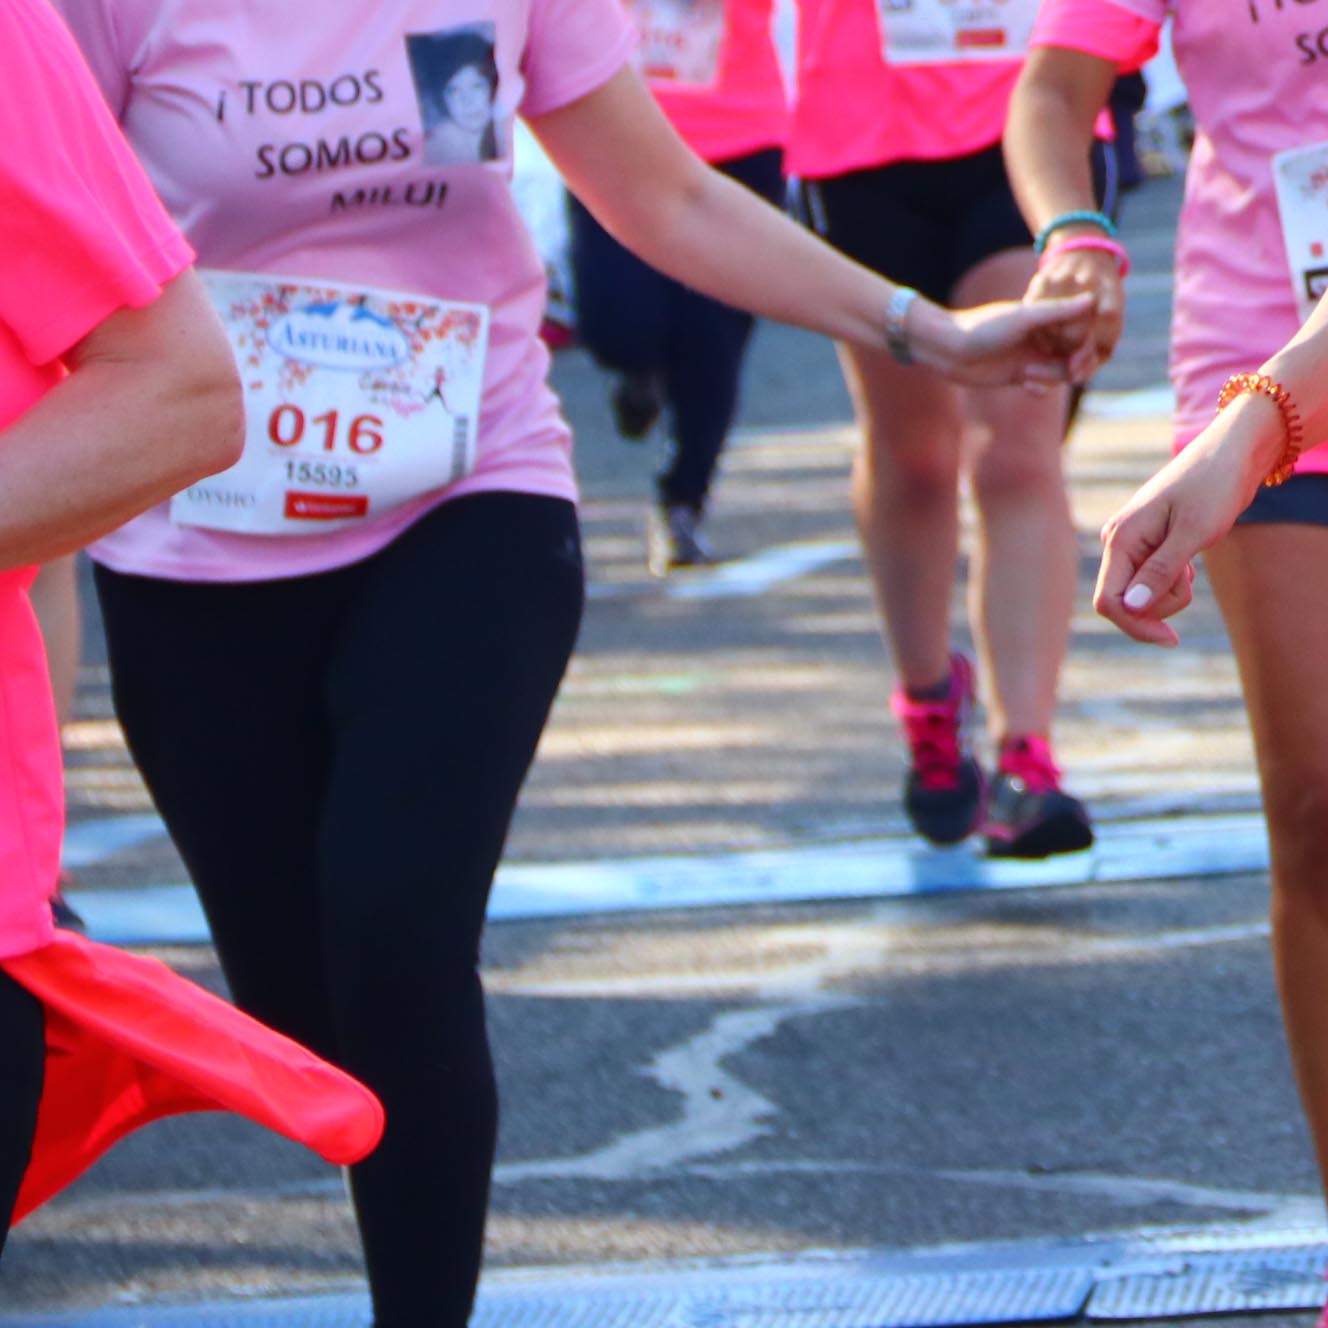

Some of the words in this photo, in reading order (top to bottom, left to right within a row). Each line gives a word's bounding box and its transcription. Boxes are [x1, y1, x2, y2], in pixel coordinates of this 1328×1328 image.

[255, 127, 412, 180] SOMOS
[283, 322, 399, 359] ASTURIANA
[267, 402, 385, 456] 016
